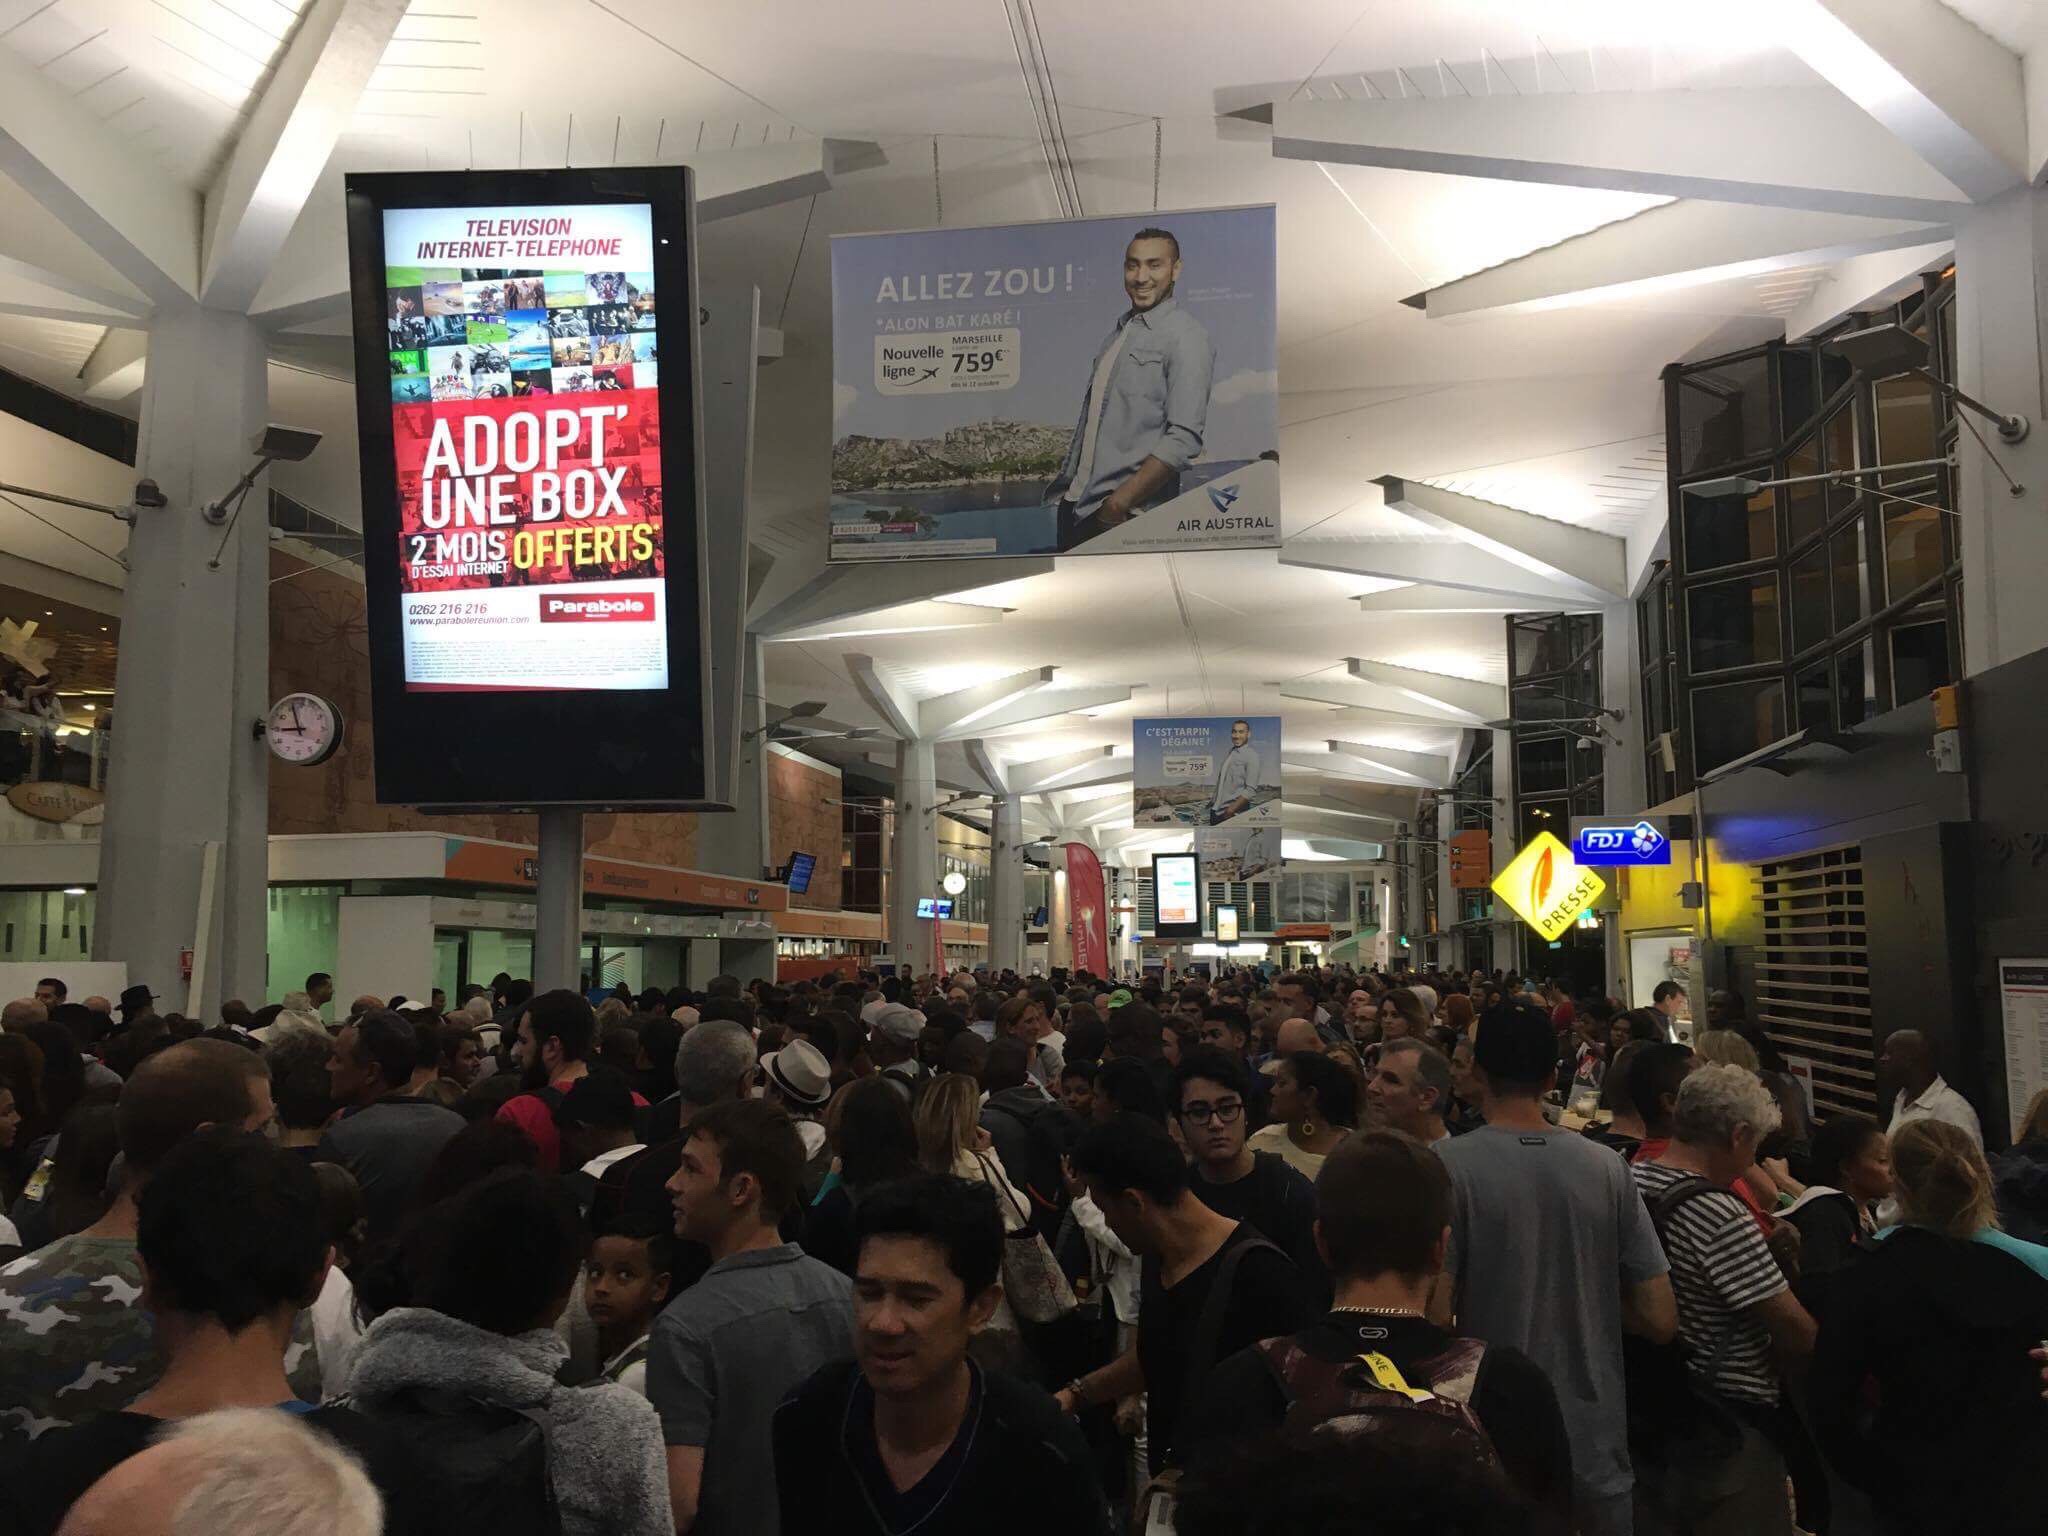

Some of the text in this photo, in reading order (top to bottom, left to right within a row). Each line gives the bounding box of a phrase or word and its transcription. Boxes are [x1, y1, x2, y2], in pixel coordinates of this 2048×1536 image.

[466, 218, 572, 237] TELEVISION
[417, 239, 622, 259] INTERNET-TELEPHONE
[876, 272, 975, 303] ALLEZ
[984, 266, 1055, 298] ZOU
[935, 314, 964, 329] BAT
[970, 308, 1012, 328] KARÉ
[952, 334, 1003, 345] MARSEILLE
[883, 345, 944, 361] Nouvelle
[882, 365, 916, 381] ligne
[422, 405, 629, 479] ADOPT'
[422, 466, 629, 529] UNE BOX
[1177, 516, 1275, 531] AIR AUSTRAL
[411, 535, 427, 566] 2
[436, 530, 506, 563] MOIS
[411, 560, 508, 579] D'ESSAI INTERNET
[409, 603, 488, 615] 0262 216 216
[549, 599, 645, 614] Parabole
[1145, 727, 1210, 737] C'EST TARPIN
[1161, 737, 1205, 747] DÉGAINE
[1586, 832, 1624, 848] FDJ
[1541, 877, 1597, 932] PRESSE
